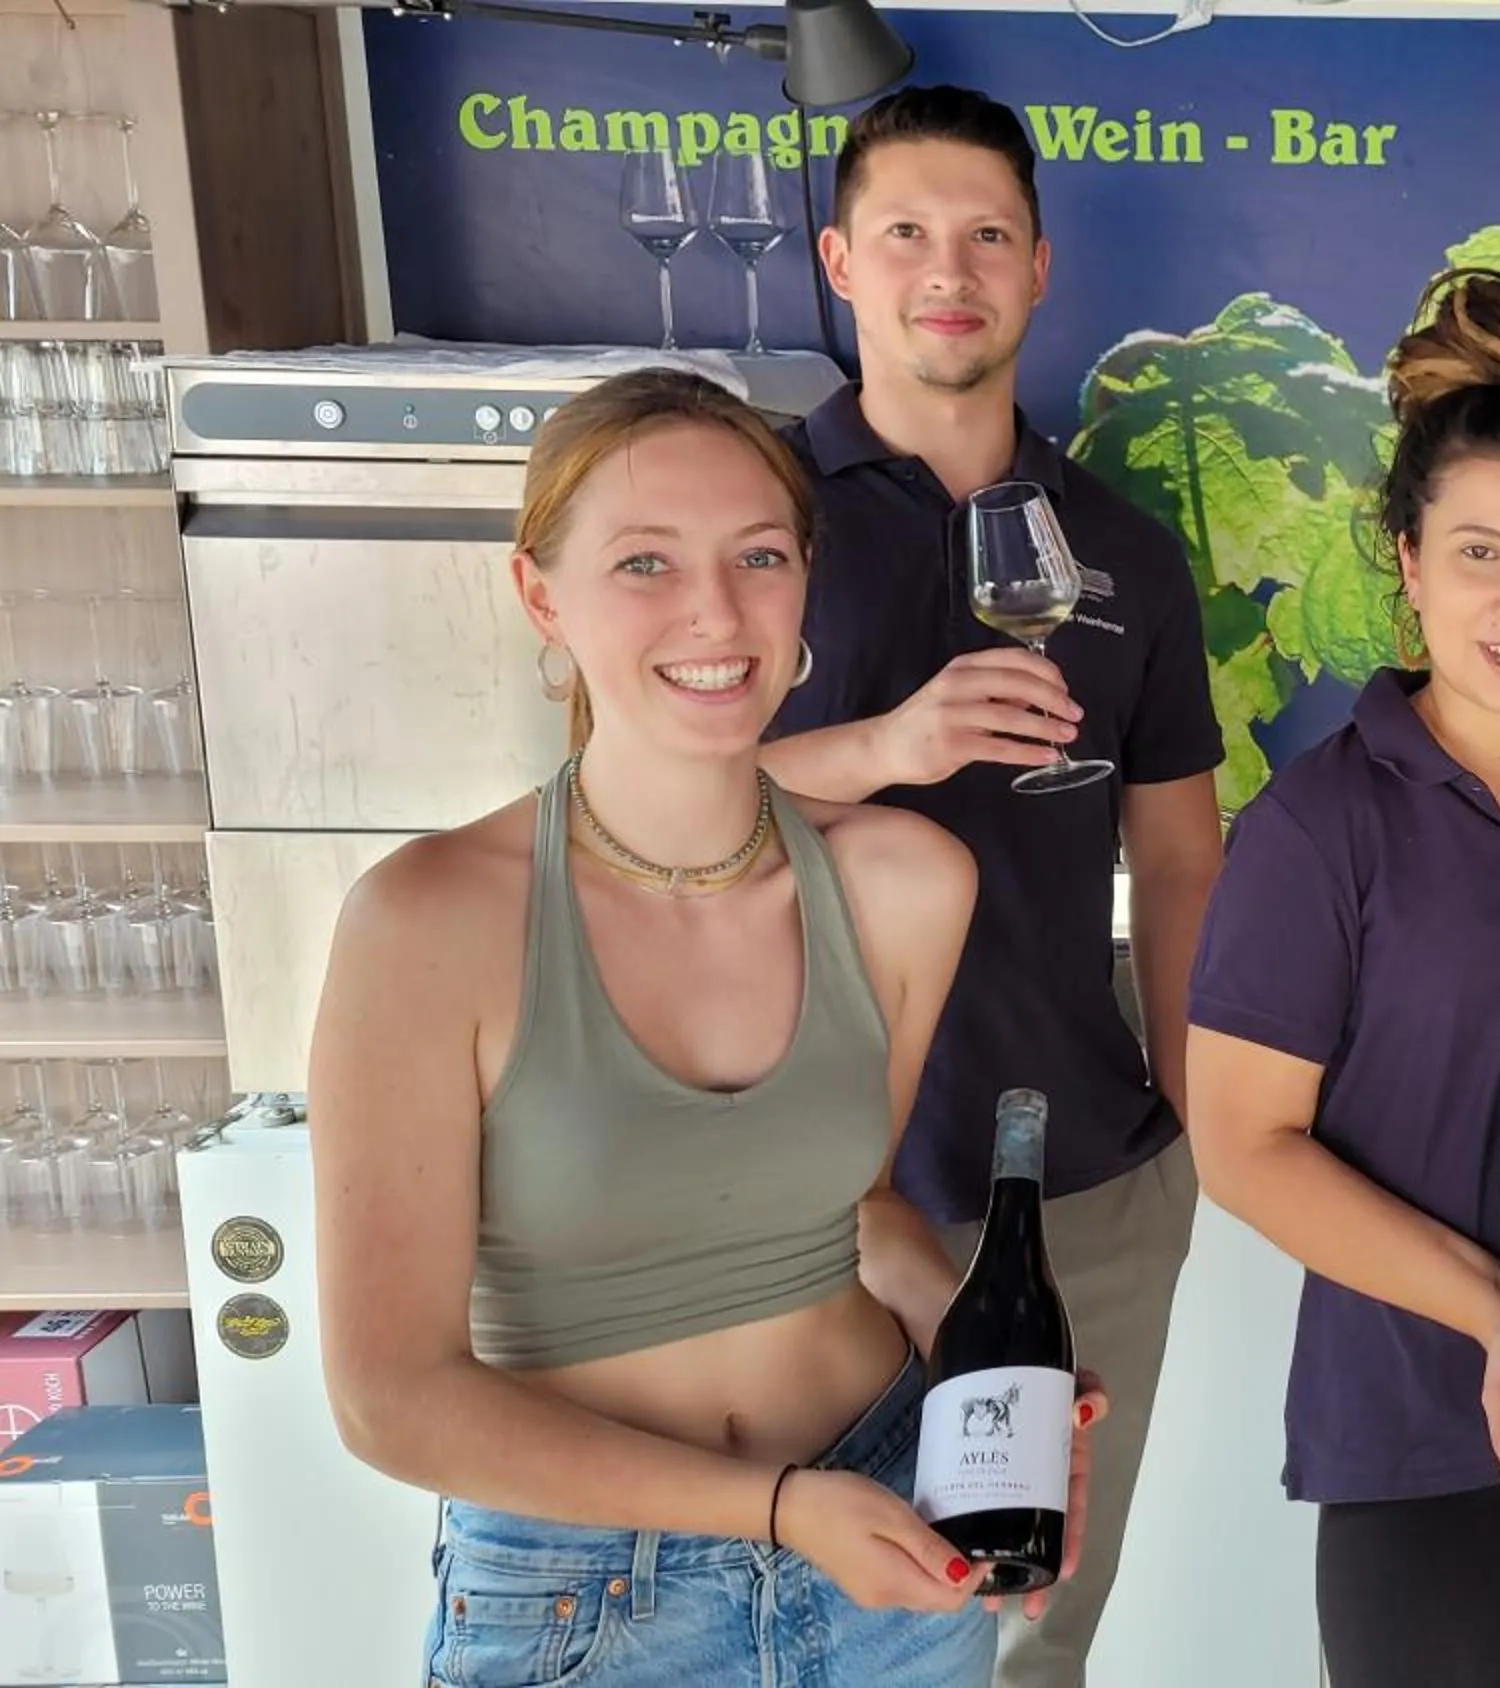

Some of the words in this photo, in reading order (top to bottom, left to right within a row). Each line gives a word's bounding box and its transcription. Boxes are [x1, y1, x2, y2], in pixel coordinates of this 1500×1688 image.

[459, 92, 849, 169] Champagn
[1025, 105, 1203, 162] Wein
[1271, 109, 1397, 165] Bar
[143, 1583, 206, 1601] POWER
